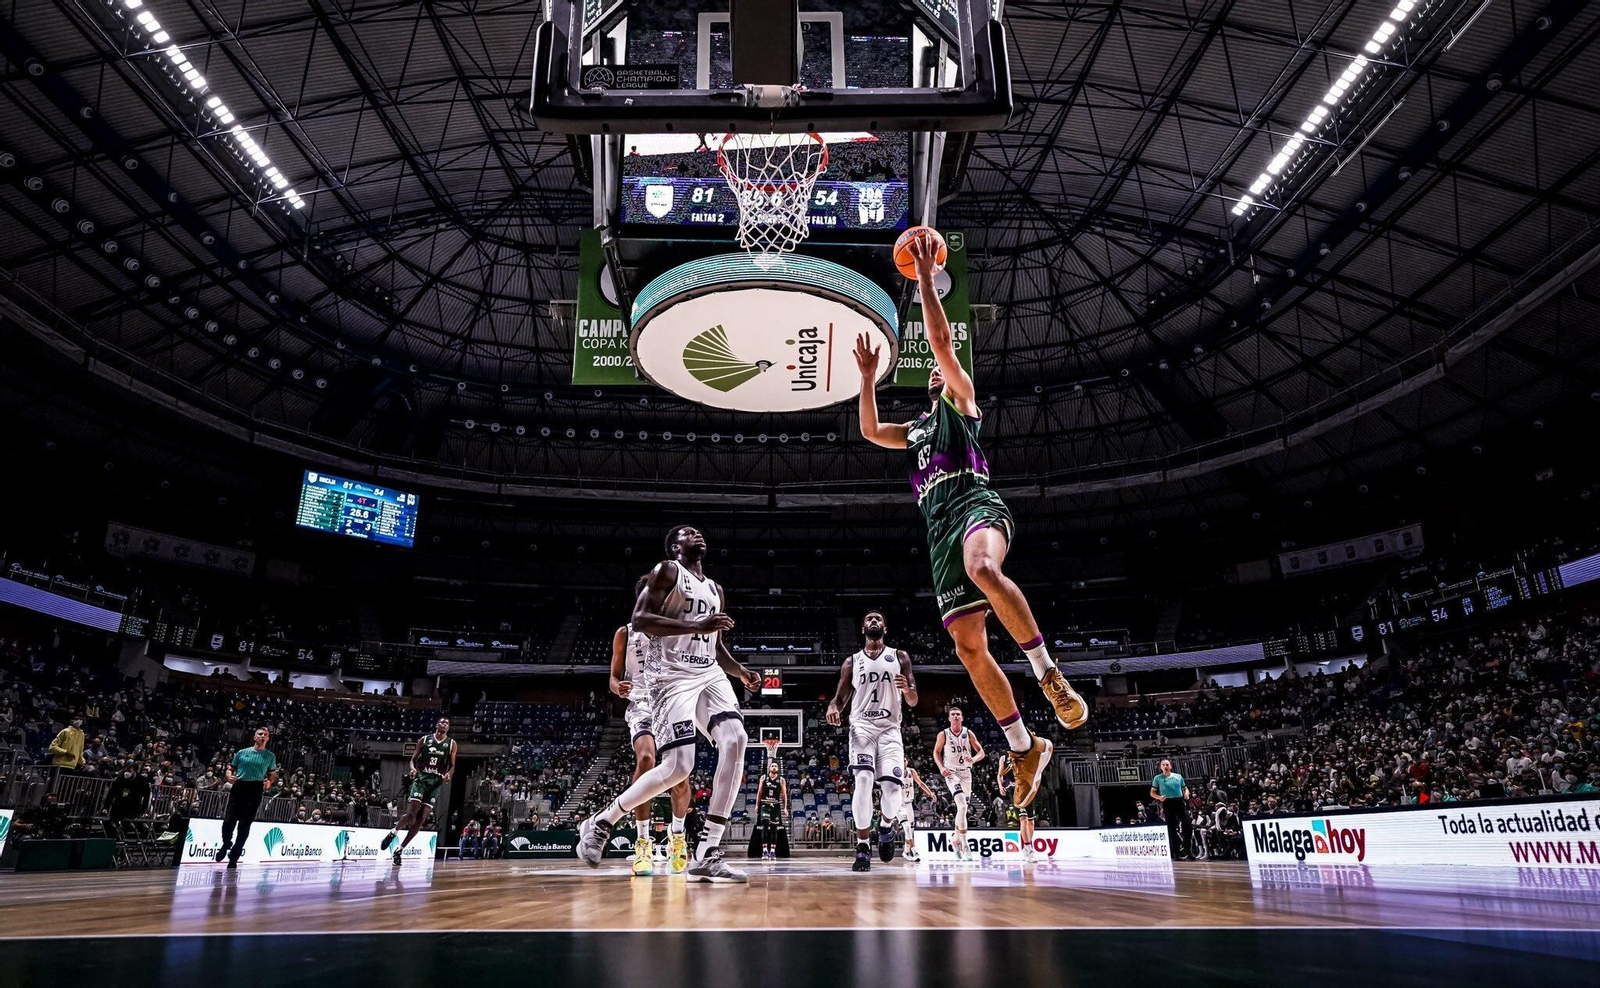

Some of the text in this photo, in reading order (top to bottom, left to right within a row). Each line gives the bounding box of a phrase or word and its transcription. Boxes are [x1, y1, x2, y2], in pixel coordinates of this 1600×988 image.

[616, 75, 677, 83] CHAMPIONS
[691, 187, 715, 203] 81
[815, 190, 839, 206] 54
[691, 213, 725, 223] FALTAS 2
[811, 216, 837, 225] FALTAS
[582, 338, 617, 349] COPA
[592, 355, 635, 367] 2000/2
[785, 326, 827, 392] Unicaja
[897, 357, 936, 369] 2016/2
[342, 481, 354, 491] 81
[373, 487, 385, 497] 54
[349, 508, 370, 519] 25.6
[346, 519, 353, 528] 2
[364, 523, 372, 531] 3
[1378, 620, 1395, 636] 81
[1431, 606, 1449, 623] 54
[238, 640, 254, 653] 81
[297, 648, 314, 661] 54
[681, 654, 710, 666] ISERBA
[764, 677, 780, 689] 20
[860, 671, 892, 685] JDA
[871, 688, 880, 703] 1
[951, 746, 968, 754] JDA
[958, 756, 965, 765] 6
[1438, 813, 1477, 835] Toda
[1478, 812, 1494, 834] la
[1497, 807, 1592, 834] actualidad
[1143, 831, 1159, 844] equipo
[1159, 832, 1167, 841] en
[1251, 819, 1366, 863] Málaga hoy
[188, 842, 221, 861] Unicaj
[281, 844, 323, 859] Unicaja Banco
[347, 844, 379, 858] Unicaja Banco
[527, 842, 552, 852] Unicaja
[927, 832, 1002, 858] Maga
[1507, 840, 1600, 865] WWW.M
